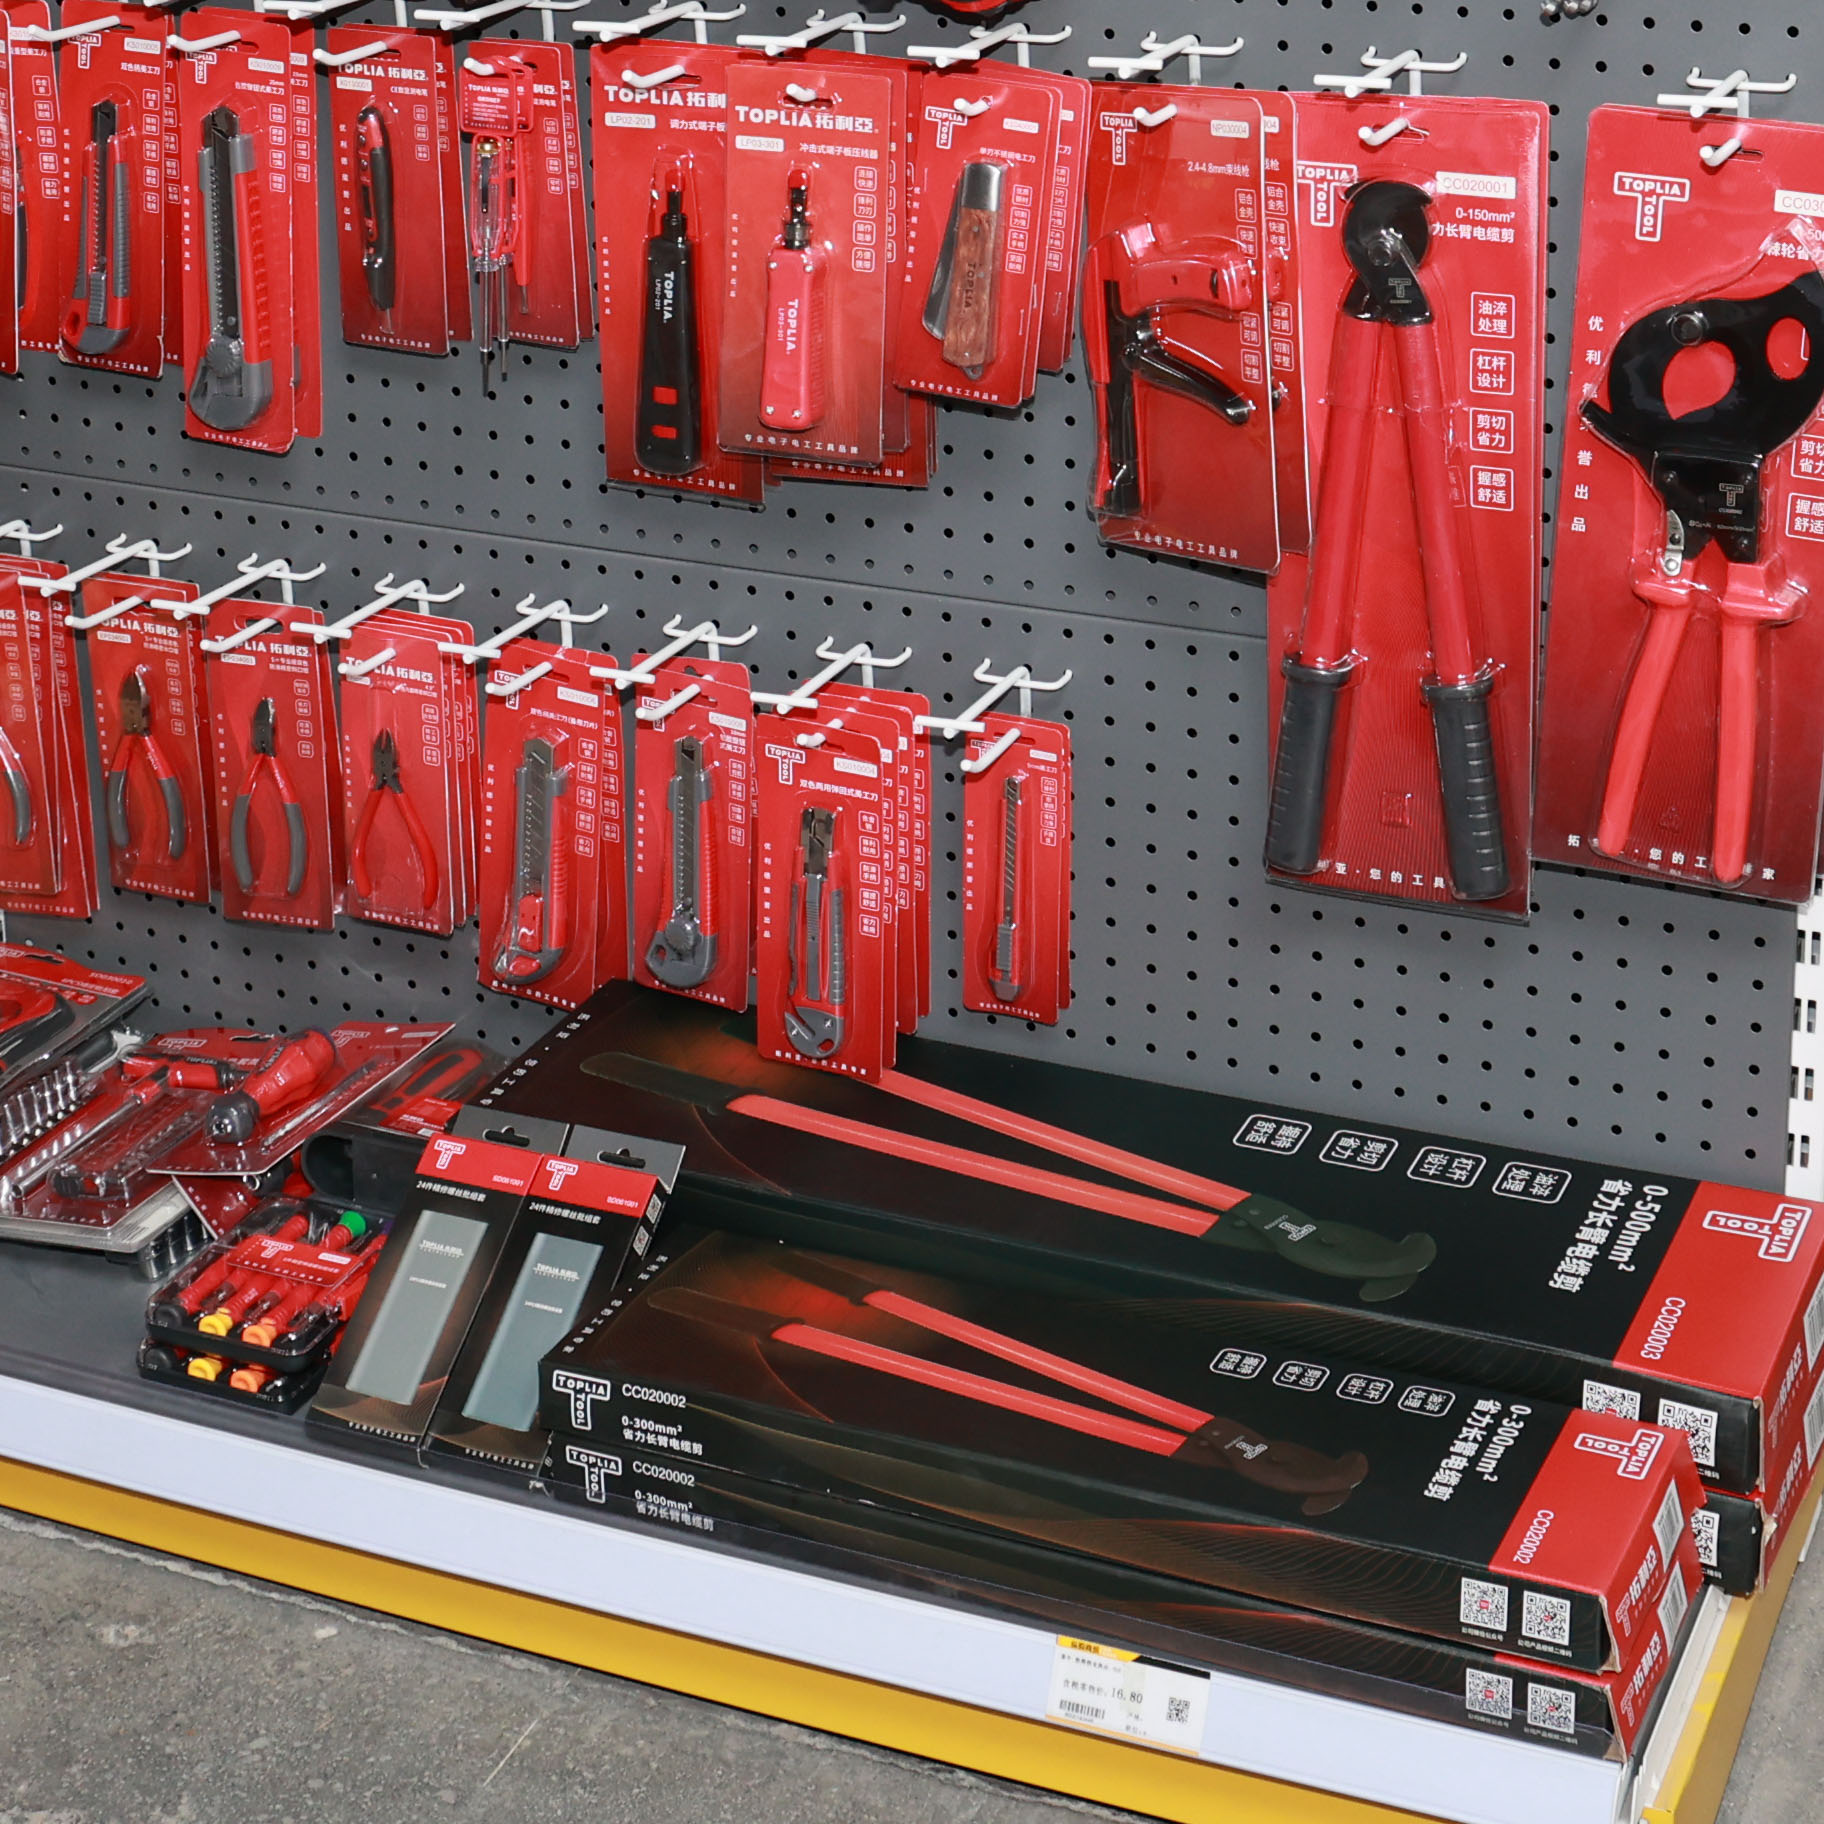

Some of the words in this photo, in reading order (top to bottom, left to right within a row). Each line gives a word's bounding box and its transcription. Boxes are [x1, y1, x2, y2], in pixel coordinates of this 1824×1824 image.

[336, 62, 385, 78] TOPLIA
[604, 86, 684, 107] TOPLIA
[608, 114, 653, 127] LP02-201
[735, 105, 812, 128] TOPLIA
[815, 113, 875, 133] 拓利亞
[930, 109, 964, 122] TOPLIA
[1104, 115, 1134, 129] TOPLIA
[939, 122, 949, 147] TOOL
[1114, 130, 1123, 161] TOOL
[1297, 165, 1350, 181] TOPLIA
[1442, 175, 1509, 194] CC020001
[1622, 177, 1682, 196] TOPLIA
[1315, 184, 1328, 221] TOOL
[1455, 208, 1515, 221] 0-150mm²
[1641, 197, 1655, 234] TOOL
[1431, 222, 1514, 243] 力长臂电缆剪
[965, 261, 976, 309] TOPLIA
[663, 272, 674, 323] TOPLIA
[1479, 299, 1508, 316] 油淬
[787, 299, 797, 355] TOPLIA
[1478, 317, 1508, 333] 处理
[1477, 355, 1507, 371] 杠杆
[1476, 372, 1507, 389] 设计
[1476, 414, 1506, 430] 剪切
[745, 433, 859, 454] 专业电子电工工具品牌
[1476, 431, 1506, 447] 省力
[1477, 471, 1506, 487] 握感
[1477, 488, 1507, 504] 舒适
[1794, 517, 1824, 534] 舒适
[769, 748, 801, 761] TOPLIA
[1549, 1179, 1618, 1294] 省力长臂电缆剪
[1608, 1183, 1670, 1273] 0-500mm²
[1714, 1215, 1776, 1237] TOOL
[1767, 1210, 1804, 1256] TOPLIA
[1640, 1296, 1687, 1361] CC020003
[558, 1376, 607, 1395] TOPLIA
[622, 1383, 686, 1409] CC020002
[576, 1394, 585, 1425] TOOL
[621, 1416, 683, 1436] 0-300mm²
[622, 1429, 703, 1457] 省力长臂电缆剪
[1423, 1398, 1503, 1502] 省力长臂电缆剪
[1485, 1404, 1533, 1483] 0-300mm²
[571, 1451, 619, 1470] TOPLIA
[589, 1468, 600, 1497] TOOL
[632, 1461, 695, 1487] CC020002
[634, 1490, 693, 1511] 0-300mm²
[636, 1502, 714, 1531] 省力长臂电缆剪
[1512, 1509, 1555, 1566] CC020002
[1111, 1688, 1143, 1704] 16.80
